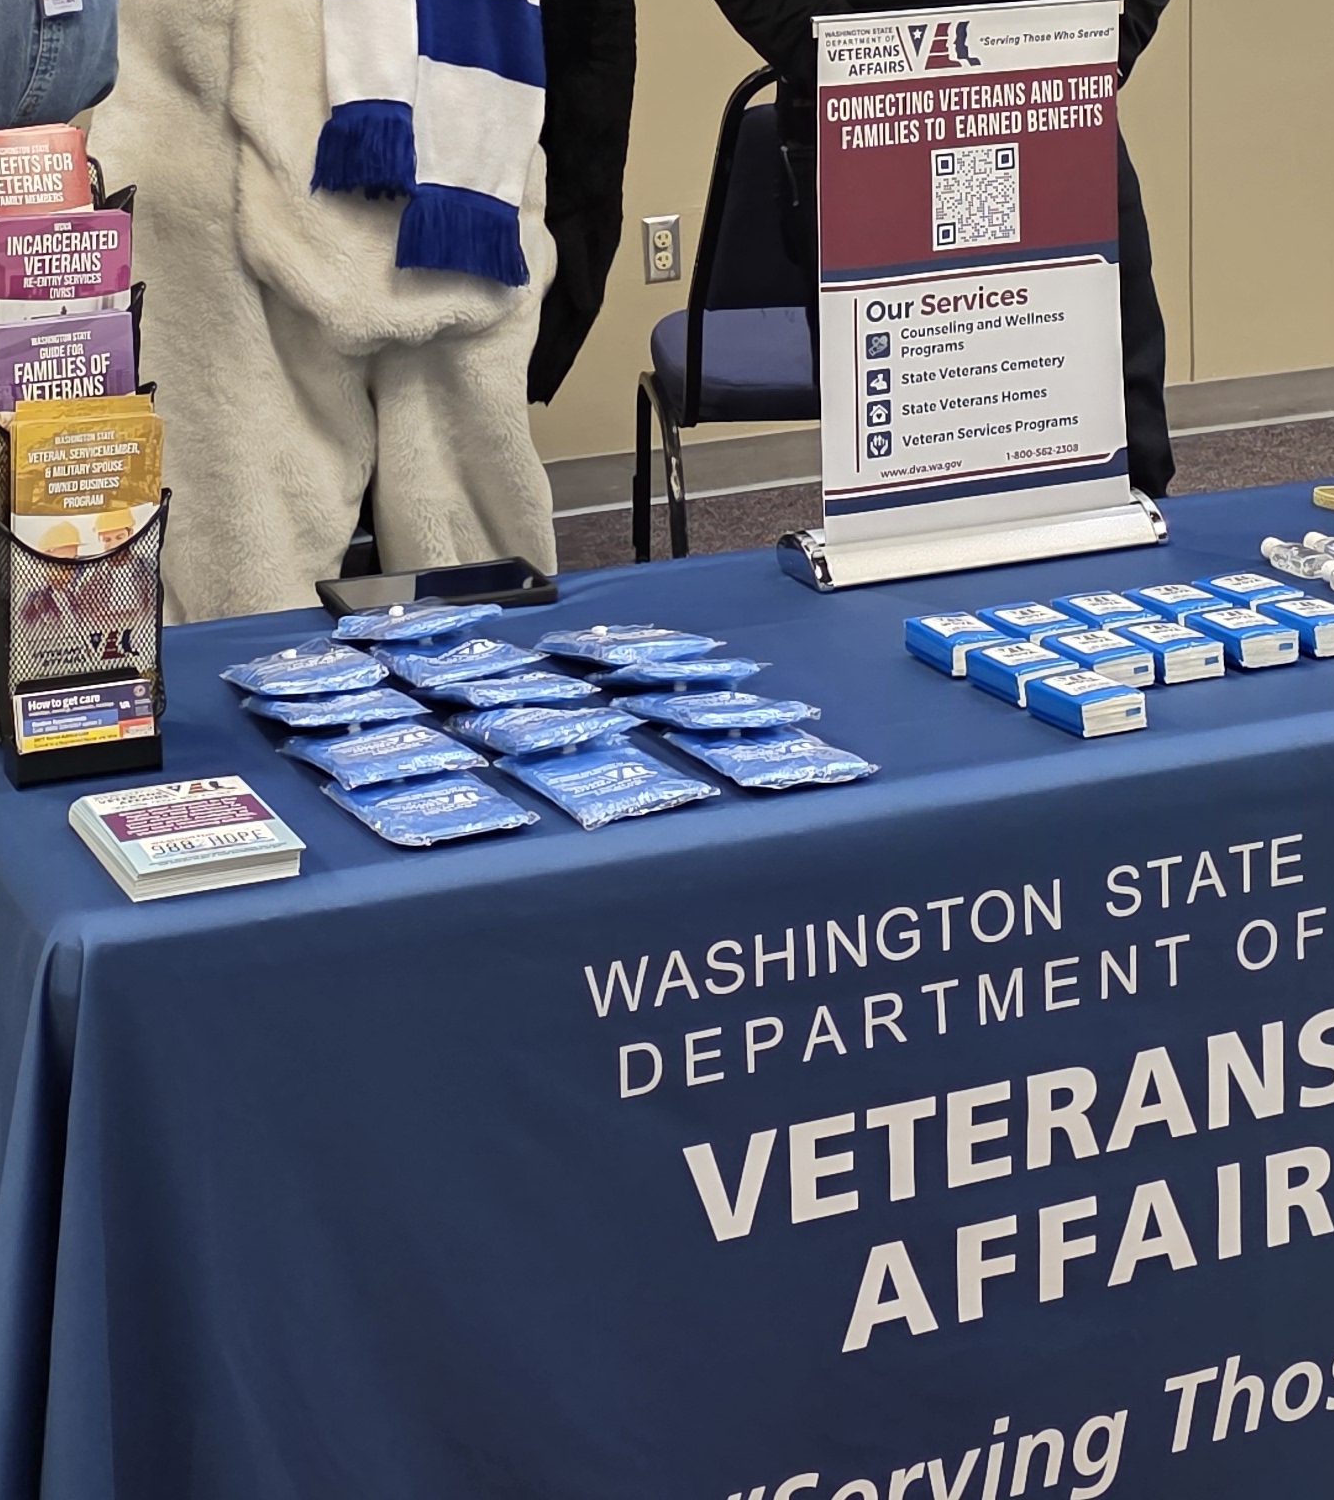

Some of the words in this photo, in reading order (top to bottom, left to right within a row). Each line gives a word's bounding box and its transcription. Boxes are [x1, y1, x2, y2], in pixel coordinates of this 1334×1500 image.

[825, 29, 870, 38] WASHINGTON
[872, 26, 893, 35] STATE
[826, 37, 883, 47] DEPARTMENT
[885, 35, 895, 43] OF
[1023, 33, 1051, 43] Those
[1054, 30, 1075, 40] Who
[827, 44, 900, 63] VETERANS
[848, 60, 905, 77] AFFAIRS
[827, 90, 934, 122] CONNECTING
[939, 82, 1026, 112] VETERANS
[1030, 79, 1064, 104] AND
[1068, 74, 1113, 100] THEIR
[841, 120, 920, 150] FAMILIES
[925, 118, 945, 141] TO
[956, 111, 1022, 138] EARNED
[1027, 103, 1103, 133] BENEFITS
[43, 153, 73, 173] FOR
[25, 193, 64, 204] MEMBERS
[7, 230, 118, 256] INCARCERATED
[23, 253, 102, 275] VETERANS
[23, 275, 62, 288] RE-ENTRY
[64, 273, 102, 285] SERVICES
[866, 300, 914, 323] Our
[920, 286, 1028, 316] Services
[901, 320, 974, 341] Counseling
[976, 317, 1002, 331] and
[1006, 310, 1065, 327] Wellness
[39, 346, 65, 359] GUIDE
[67, 343, 84, 356] FOR
[901, 340, 964, 358] Programs
[14, 356, 87, 384] FAMILIES
[90, 353, 111, 374] OF
[901, 371, 936, 385] State
[939, 362, 997, 380] Veterans
[1001, 355, 1065, 373] Cemetery
[22, 377, 104, 401] VETERANS
[902, 402, 936, 416] State
[939, 394, 998, 411] Veterans
[1002, 388, 1047, 403] Homes
[902, 429, 954, 448] Veteran
[957, 422, 1012, 440] Services
[1015, 415, 1079, 433] Programs
[52, 463, 91, 477] MILITARY
[92, 460, 124, 474] SPOUSE
[880, 459, 963, 479] www.dva.wa.gov
[48, 480, 78, 494] OWNED
[79, 476, 120, 490] BUSINESS
[63, 494, 104, 509] PROGRAM
[28, 700, 50, 711] How
[51, 698, 62, 708] to
[63, 696, 78, 709] get
[79, 694, 100, 705] care
[151, 839, 196, 855] 988
[210, 829, 268, 848] HOPE
[584, 879, 1063, 1017] WASHINGTON
[1106, 833, 1305, 917] STATE
[619, 935, 1192, 1098] DEPARTMENT
[1236, 907, 1328, 971] OF
